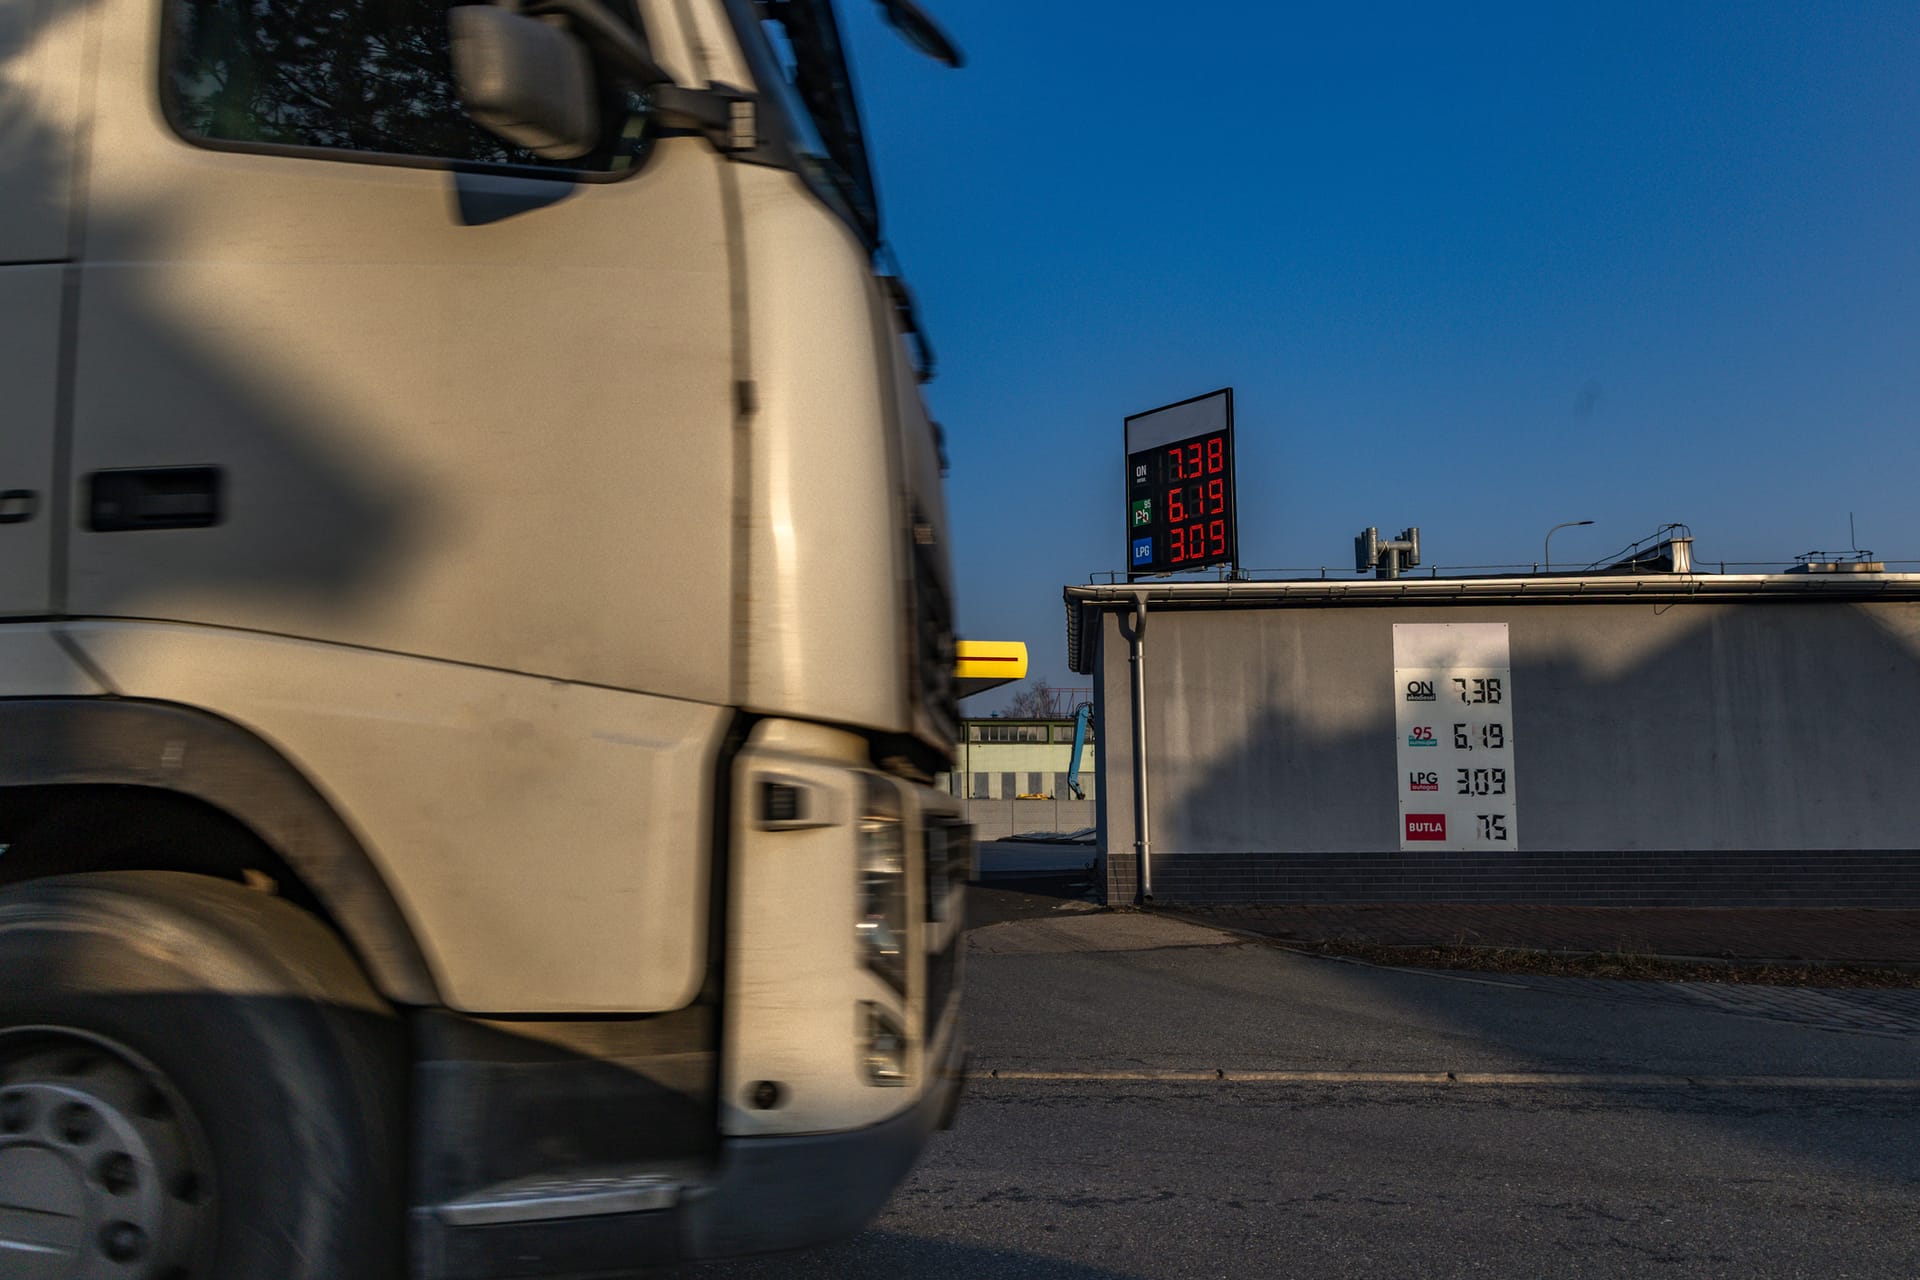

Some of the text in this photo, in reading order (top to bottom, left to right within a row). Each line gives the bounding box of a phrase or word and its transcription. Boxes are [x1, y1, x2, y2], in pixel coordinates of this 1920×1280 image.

[1168, 437, 1224, 480] 7.38
[1136, 464, 1147, 478] ON
[1168, 478, 1224, 523] 6.19
[1170, 519, 1225, 563] 3.09
[1135, 545, 1150, 558] LPG
[1407, 681, 1433, 695] ON
[1412, 726, 1433, 740] 95
[1453, 723, 1504, 751] 6,19
[1410, 771, 1438, 784] LPG
[1456, 768, 1506, 796] 3,09
[1409, 822, 1443, 832] BUTLA
[1476, 814, 1507, 841] 75
